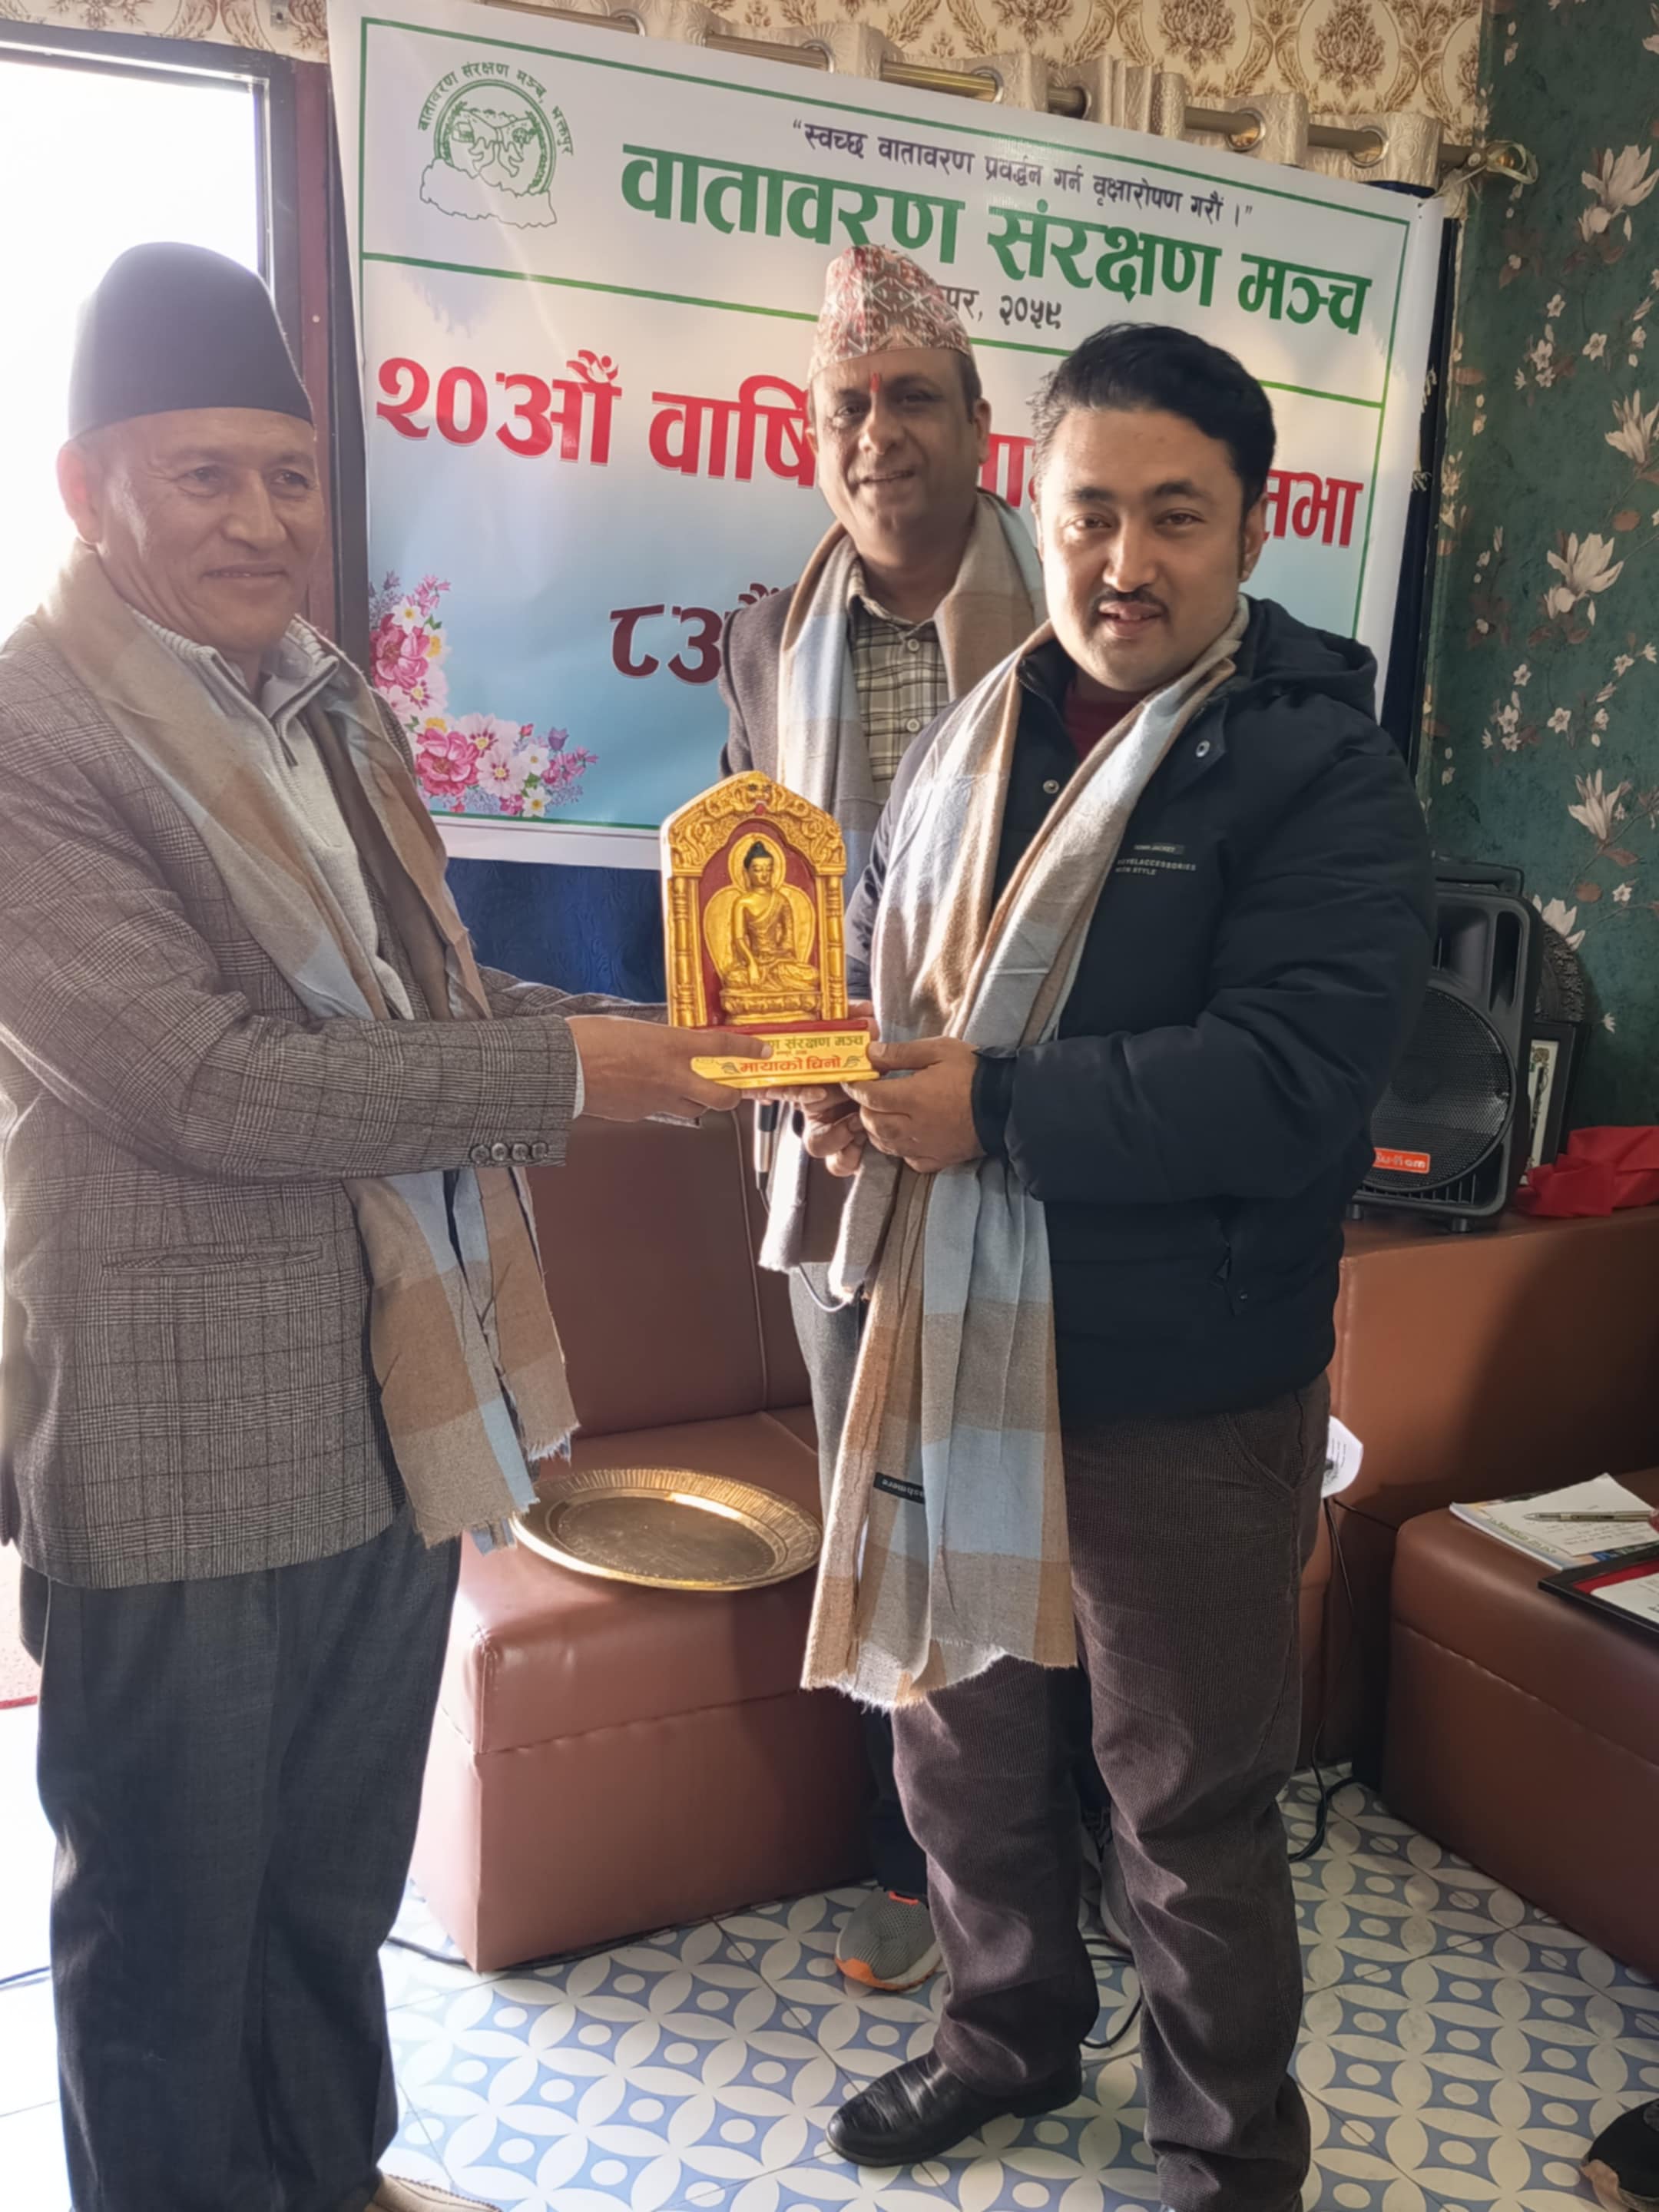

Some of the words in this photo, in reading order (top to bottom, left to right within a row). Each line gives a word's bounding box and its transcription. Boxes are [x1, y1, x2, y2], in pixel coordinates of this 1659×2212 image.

[461, 61, 510, 77] संरक्षण
[878, 137, 975, 175] वातावरण
[1054, 164, 1084, 193] गर्न
[1093, 175, 1183, 213] वृक्षारोपण
[621, 144, 965, 264] वातावरण
[988, 199, 1222, 307] संरक्षण
[1237, 253, 1373, 335] मञ्च
[999, 295, 1061, 329] २०५९
[740, 1057, 803, 1073] मायाको
